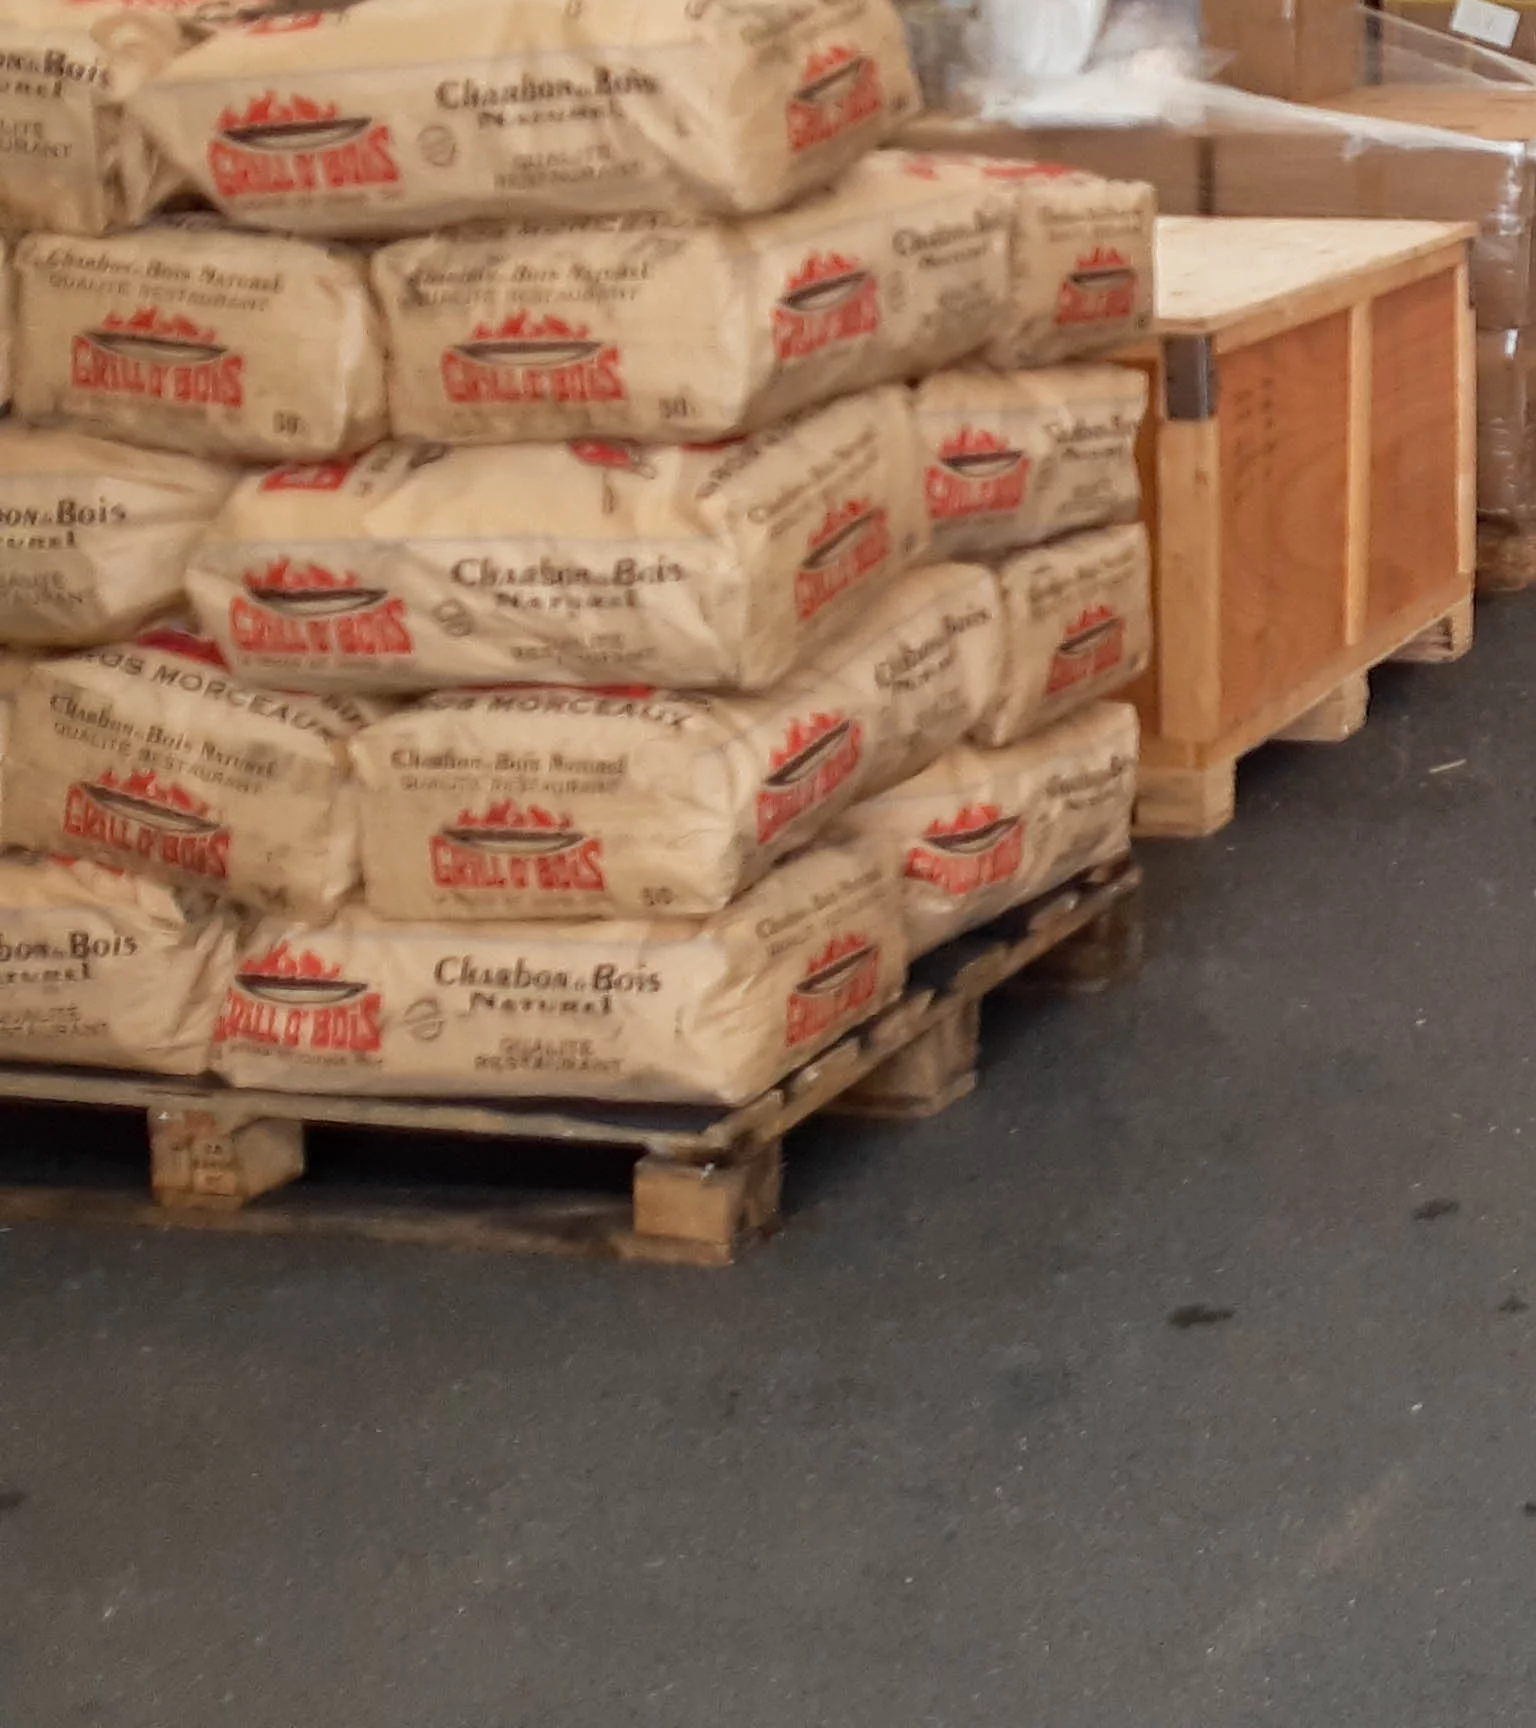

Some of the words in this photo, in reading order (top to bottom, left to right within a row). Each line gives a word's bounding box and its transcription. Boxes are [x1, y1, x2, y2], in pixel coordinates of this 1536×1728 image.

[56, 497, 127, 525] Bois
[451, 556, 591, 587] Charbon
[613, 554, 687, 587] Bois
[69, 930, 139, 962] Bois
[434, 955, 569, 988] Charbon
[591, 960, 663, 995] Bois
[309, 993, 383, 1052] BOIS
